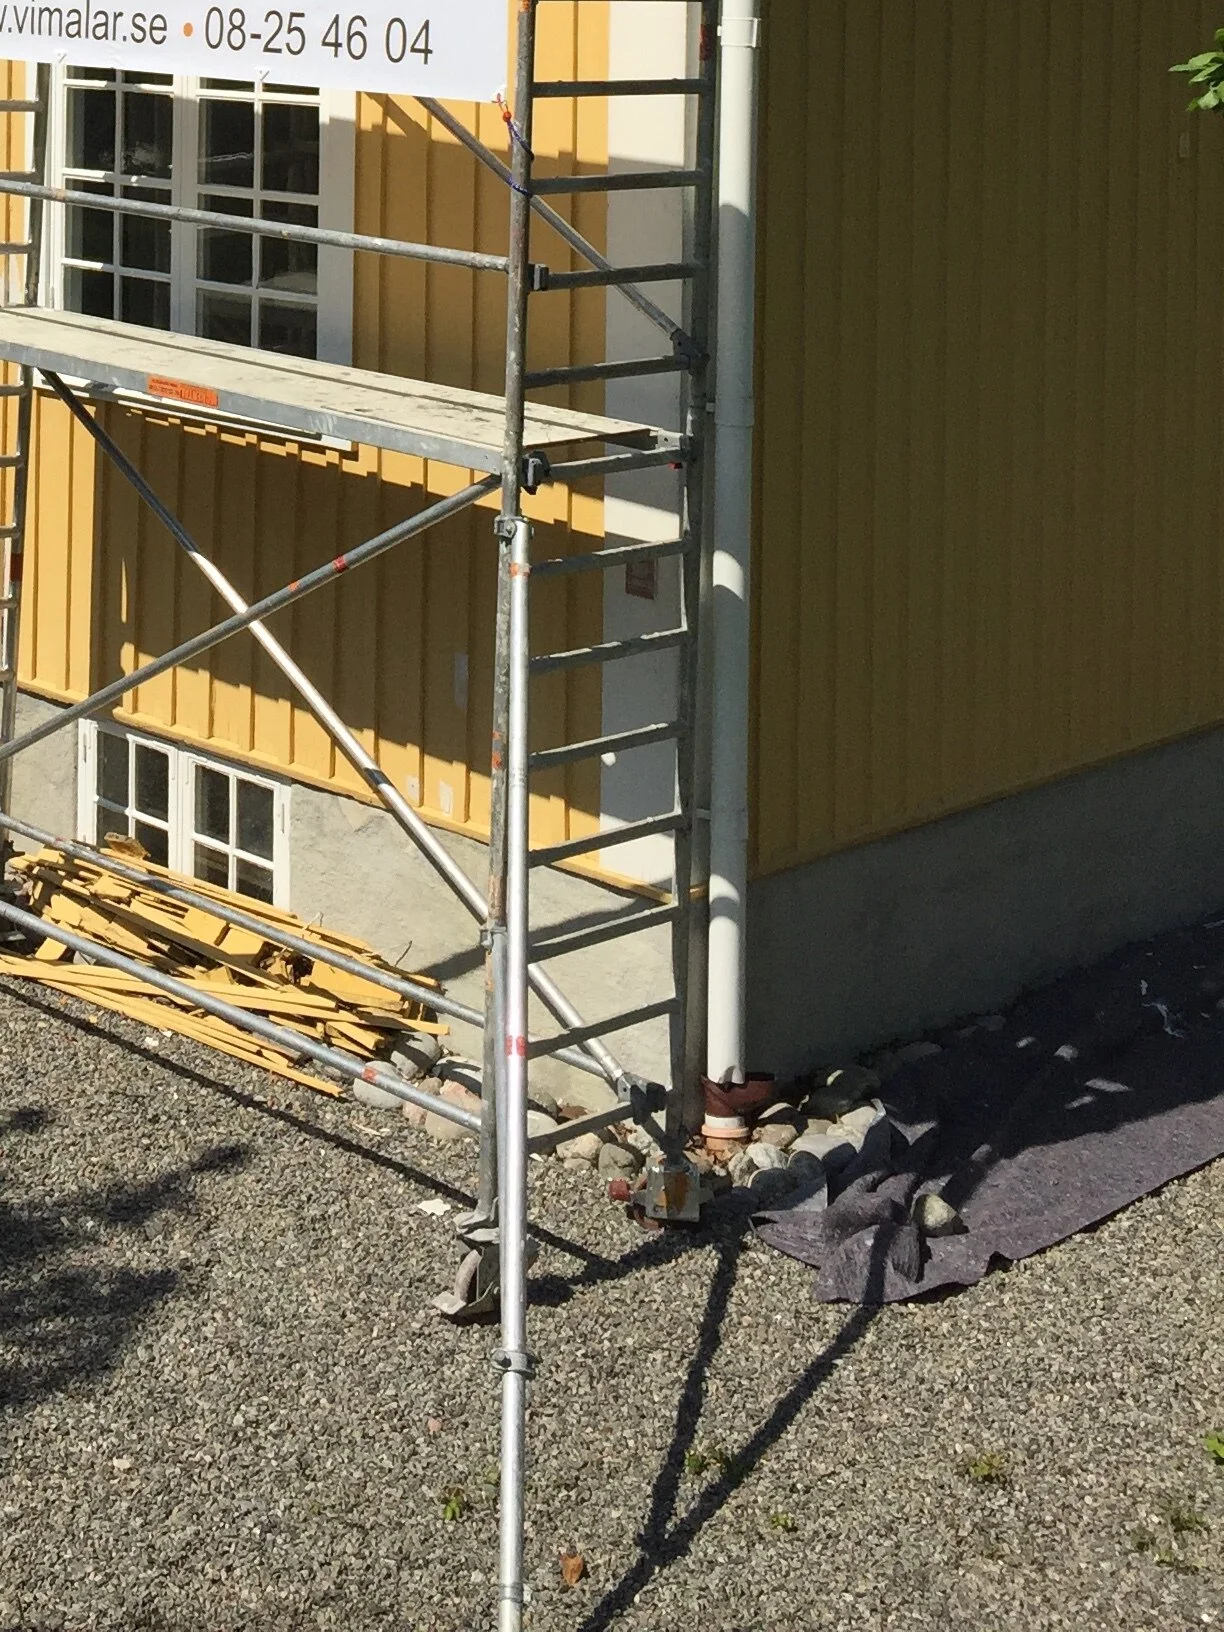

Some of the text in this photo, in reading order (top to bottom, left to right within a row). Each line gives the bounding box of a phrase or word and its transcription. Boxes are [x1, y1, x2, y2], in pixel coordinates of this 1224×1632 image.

[204, 6, 307, 56] 08-25
[320, 13, 369, 61] 46
[384, 17, 435, 66] 04
